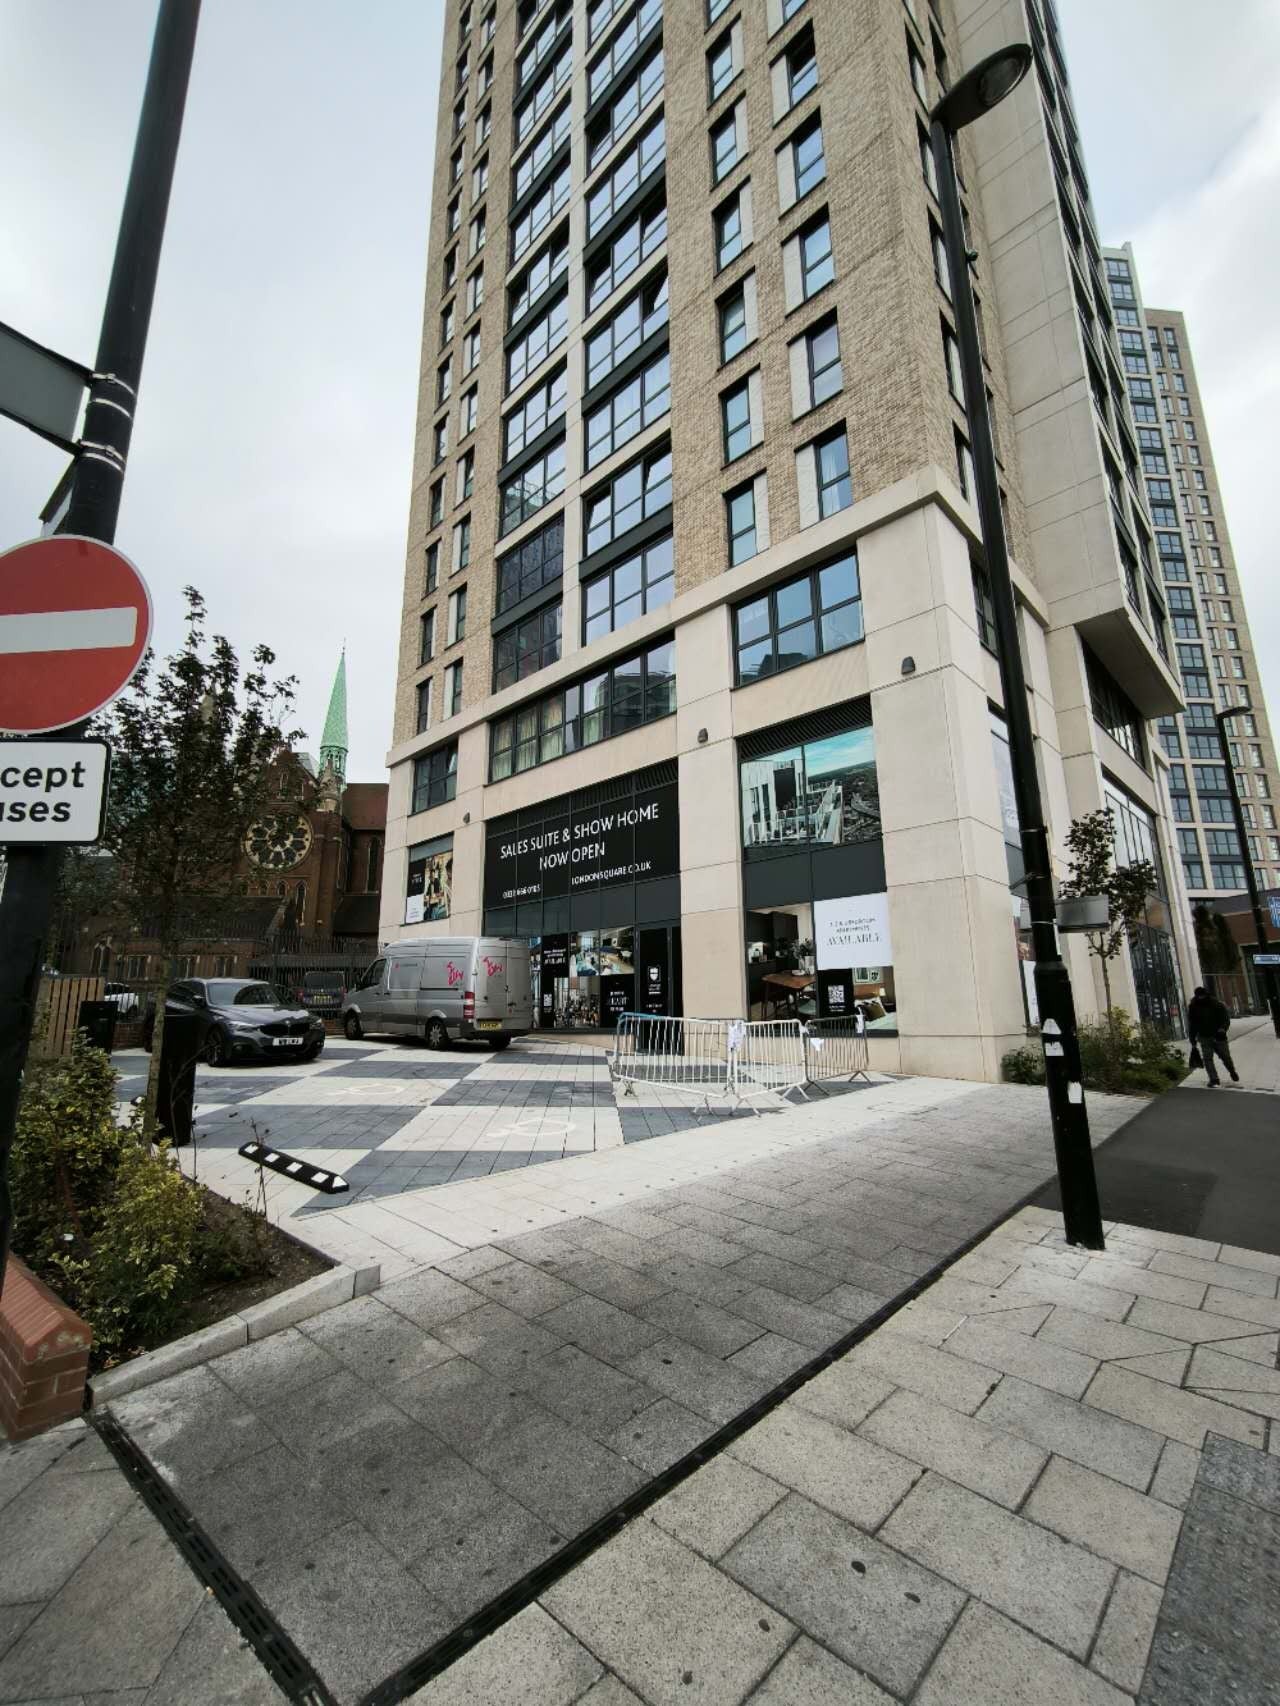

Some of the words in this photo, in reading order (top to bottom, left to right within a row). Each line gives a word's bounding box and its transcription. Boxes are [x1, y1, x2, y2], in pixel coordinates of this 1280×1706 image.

[500, 839, 528, 860] SALES
[530, 831, 559, 851] SUITE
[562, 828, 571, 843] &
[574, 815, 614, 840] SHOW
[617, 803, 660, 829] HOME
[539, 851, 569, 871] NOW
[571, 842, 605, 863] OPEN
